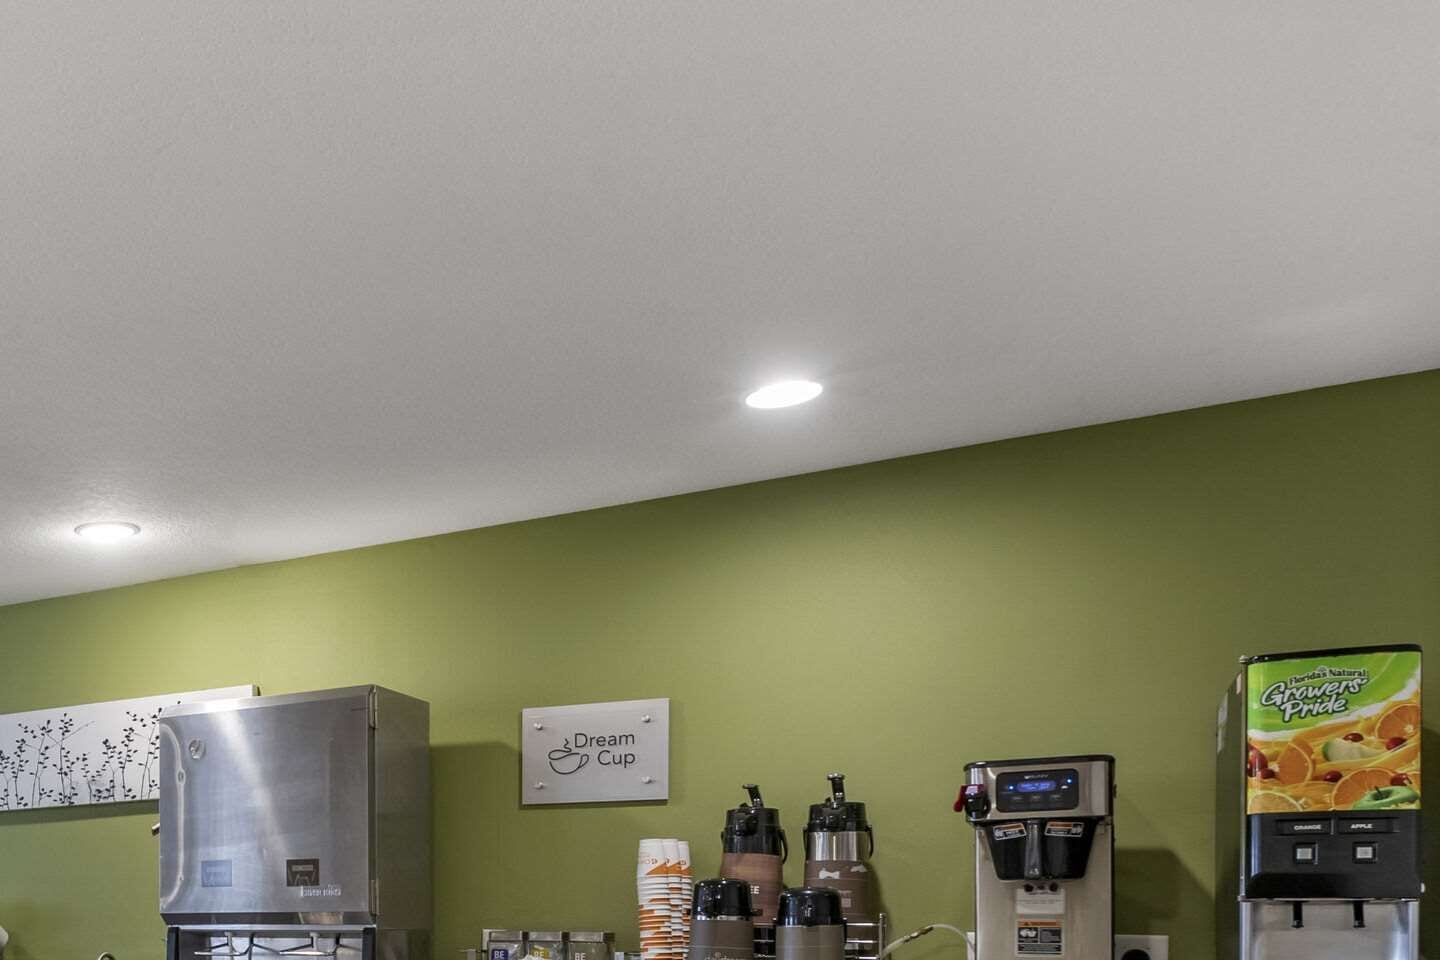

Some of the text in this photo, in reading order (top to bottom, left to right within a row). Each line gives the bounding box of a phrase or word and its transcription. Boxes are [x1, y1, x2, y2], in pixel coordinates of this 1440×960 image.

[1289, 670, 1328, 686] Florida's
[1261, 676, 1369, 706] Growers'
[1280, 694, 1347, 722] Pride
[574, 732, 635, 748] Dream
[597, 750, 636, 768] Cup
[1293, 823, 1322, 831] ORANGE
[493, 950, 505, 959] BE
